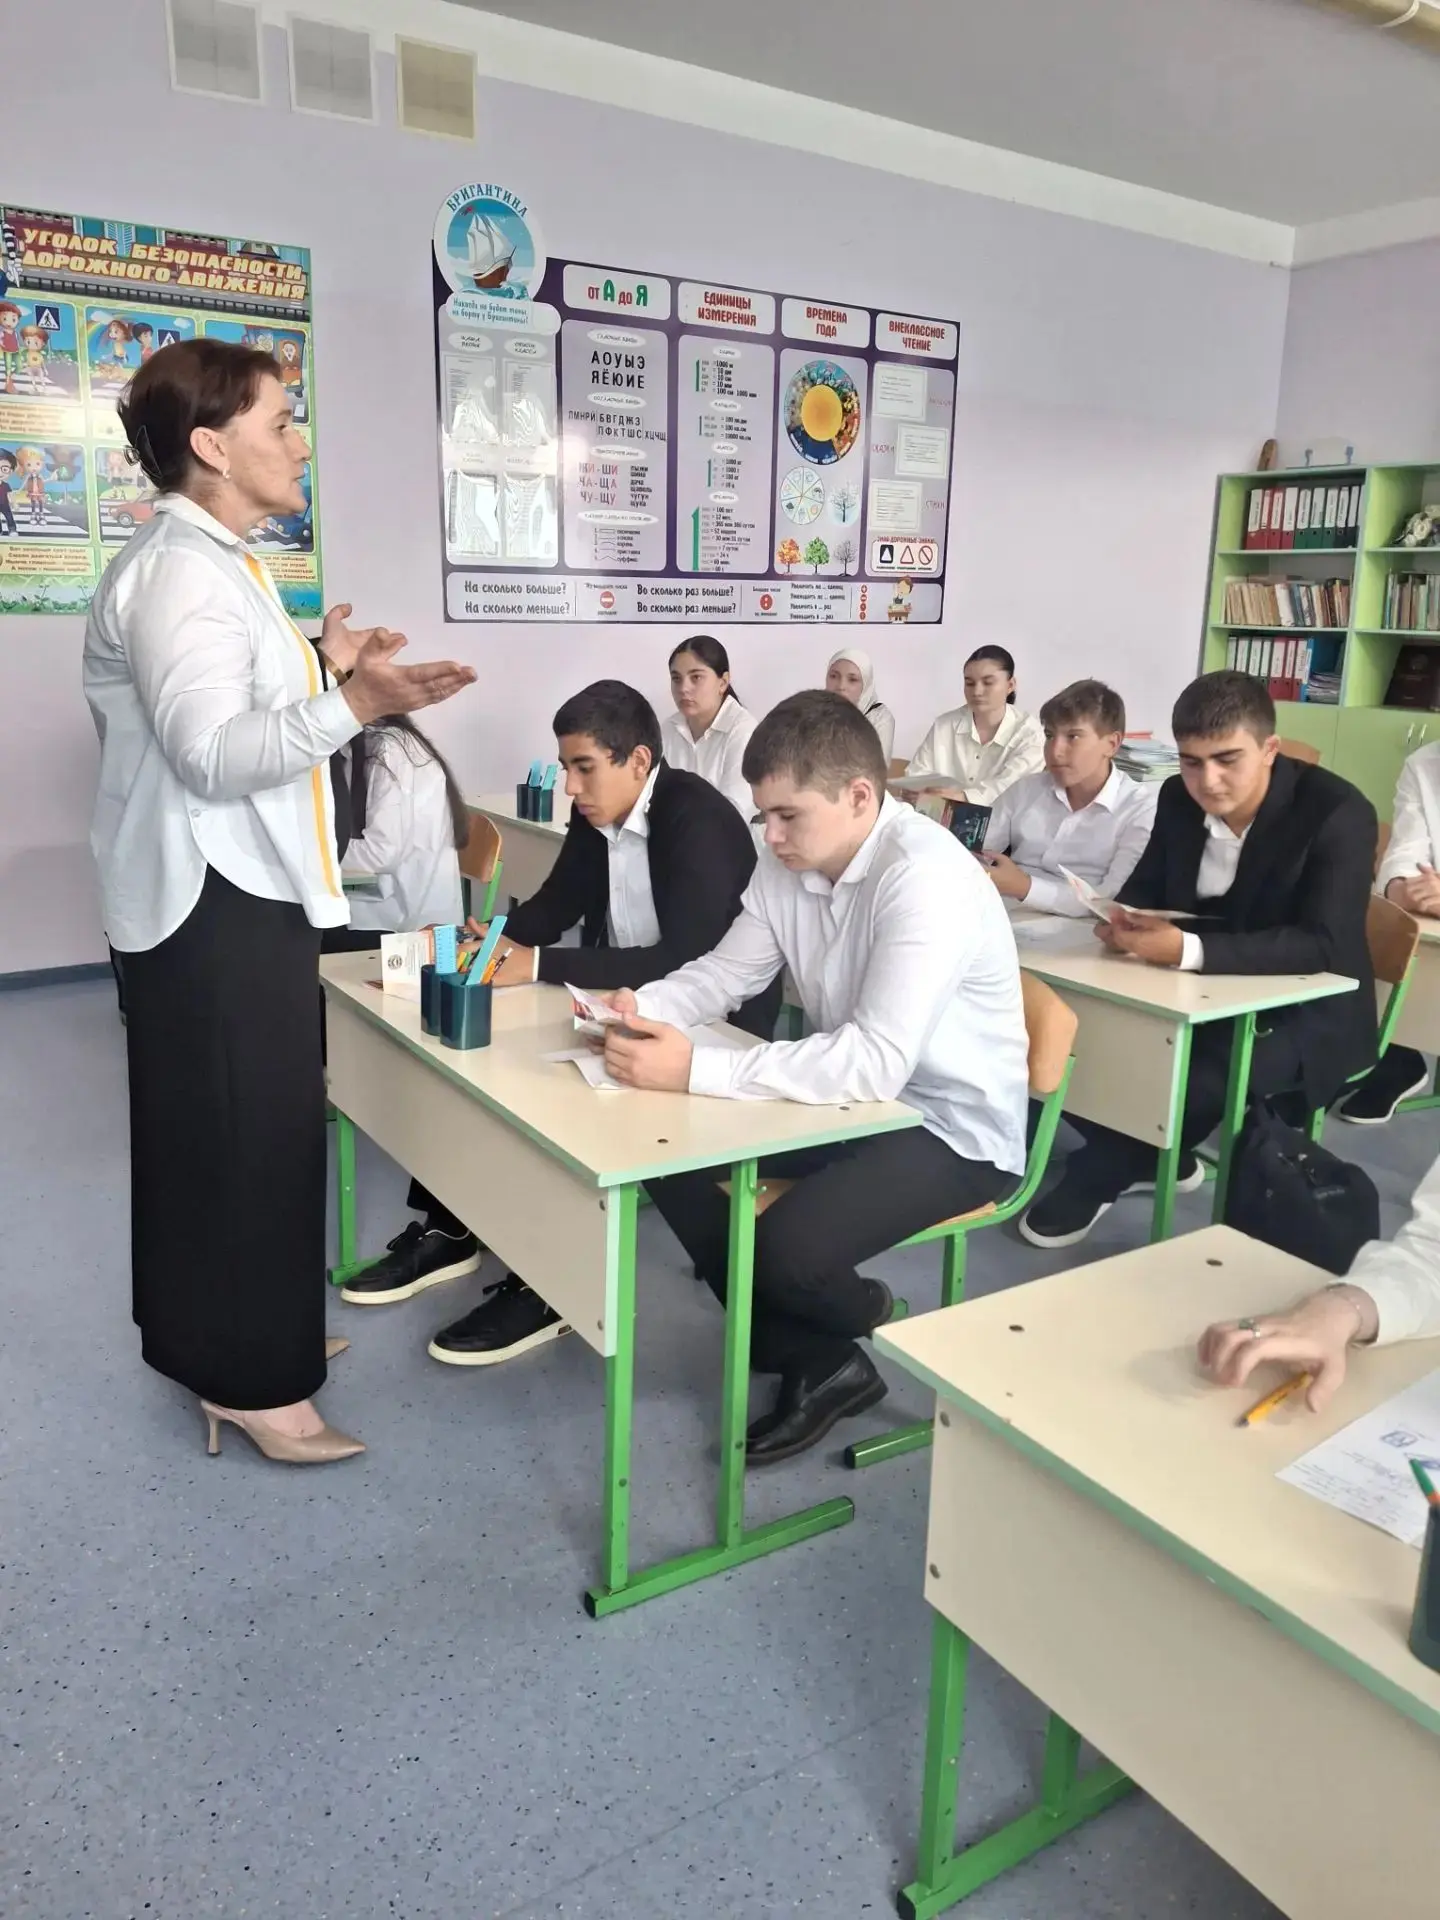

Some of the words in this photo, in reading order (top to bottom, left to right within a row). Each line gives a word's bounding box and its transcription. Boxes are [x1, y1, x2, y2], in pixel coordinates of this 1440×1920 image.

[447, 184, 529, 218] БРИГАНТИНА
[23, 228, 118, 256] УГОЛОК
[131, 243, 304, 281] БЕЗОПАСНОСТИ
[22, 249, 172, 283] ДОРОЖНОГО
[177, 272, 307, 300] ДВИЖЕНИЯ
[603, 279, 616, 302] А
[636, 284, 648, 307] Я
[704, 292, 752, 310] ЕДИНИЦЫ
[698, 307, 757, 327] ИЗМЕРЕНИЯ
[806, 306, 848, 324] ВРЕМЕНА
[816, 323, 837, 337] ГОДА
[889, 320, 946, 339] ВНЕКЛАССНОЕ
[902, 337, 932, 352] ЧТЕНИЕ
[464, 580, 478, 592] На
[482, 584, 522, 594] сколько
[526, 582, 567, 594] больше?
[637, 584, 648, 594] Во
[650, 587, 683, 596] сколько
[685, 588, 699, 599] раз
[702, 586, 734, 596] больше?
[465, 601, 479, 613] На
[483, 604, 523, 614] сколько
[527, 602, 570, 614] меньше?
[637, 602, 648, 612] Во
[650, 605, 683, 613] сколько
[685, 605, 699, 616] раз
[702, 603, 736, 613] меньше?
